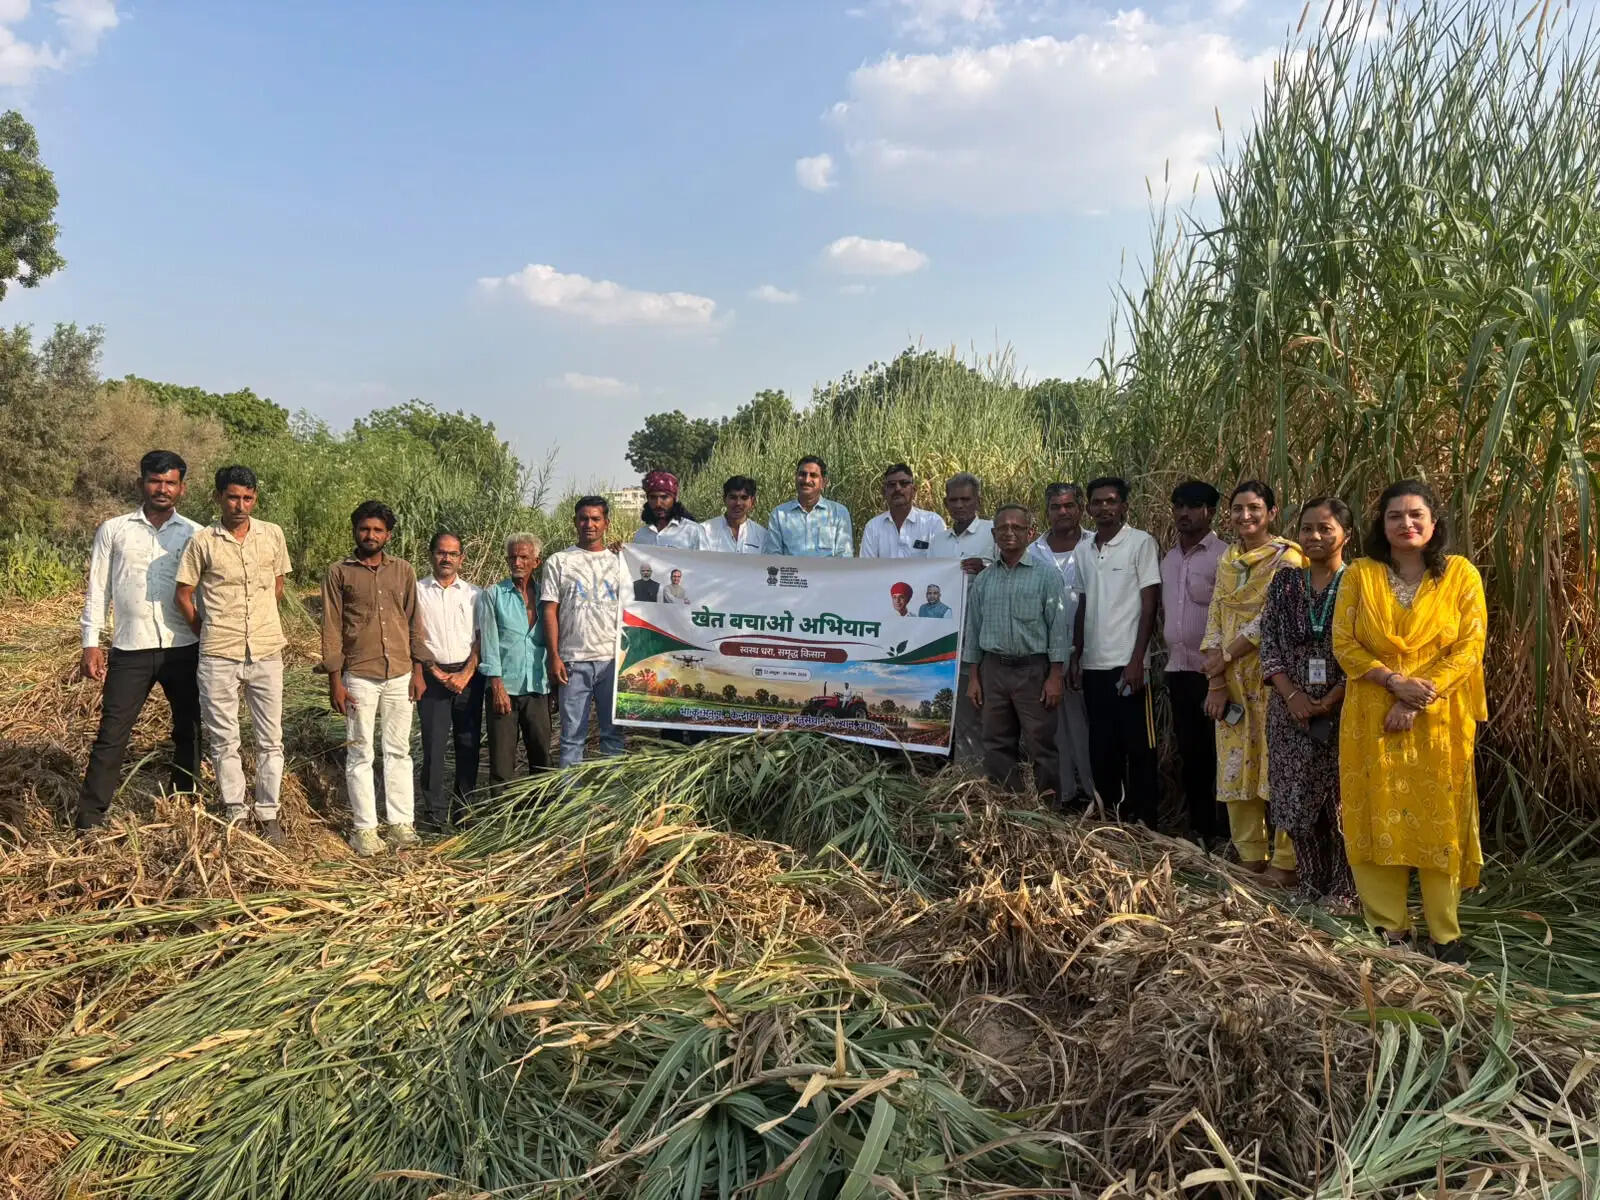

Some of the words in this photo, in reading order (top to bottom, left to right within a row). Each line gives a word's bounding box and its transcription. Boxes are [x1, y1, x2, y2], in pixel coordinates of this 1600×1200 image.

[691, 606, 725, 628] खेत
[730, 611, 794, 632] बचाओ
[799, 613, 881, 638] अभियान
[739, 646, 758, 655] स्वस्थ
[778, 648, 798, 660] समृद्ध
[800, 648, 826, 659] किसान
